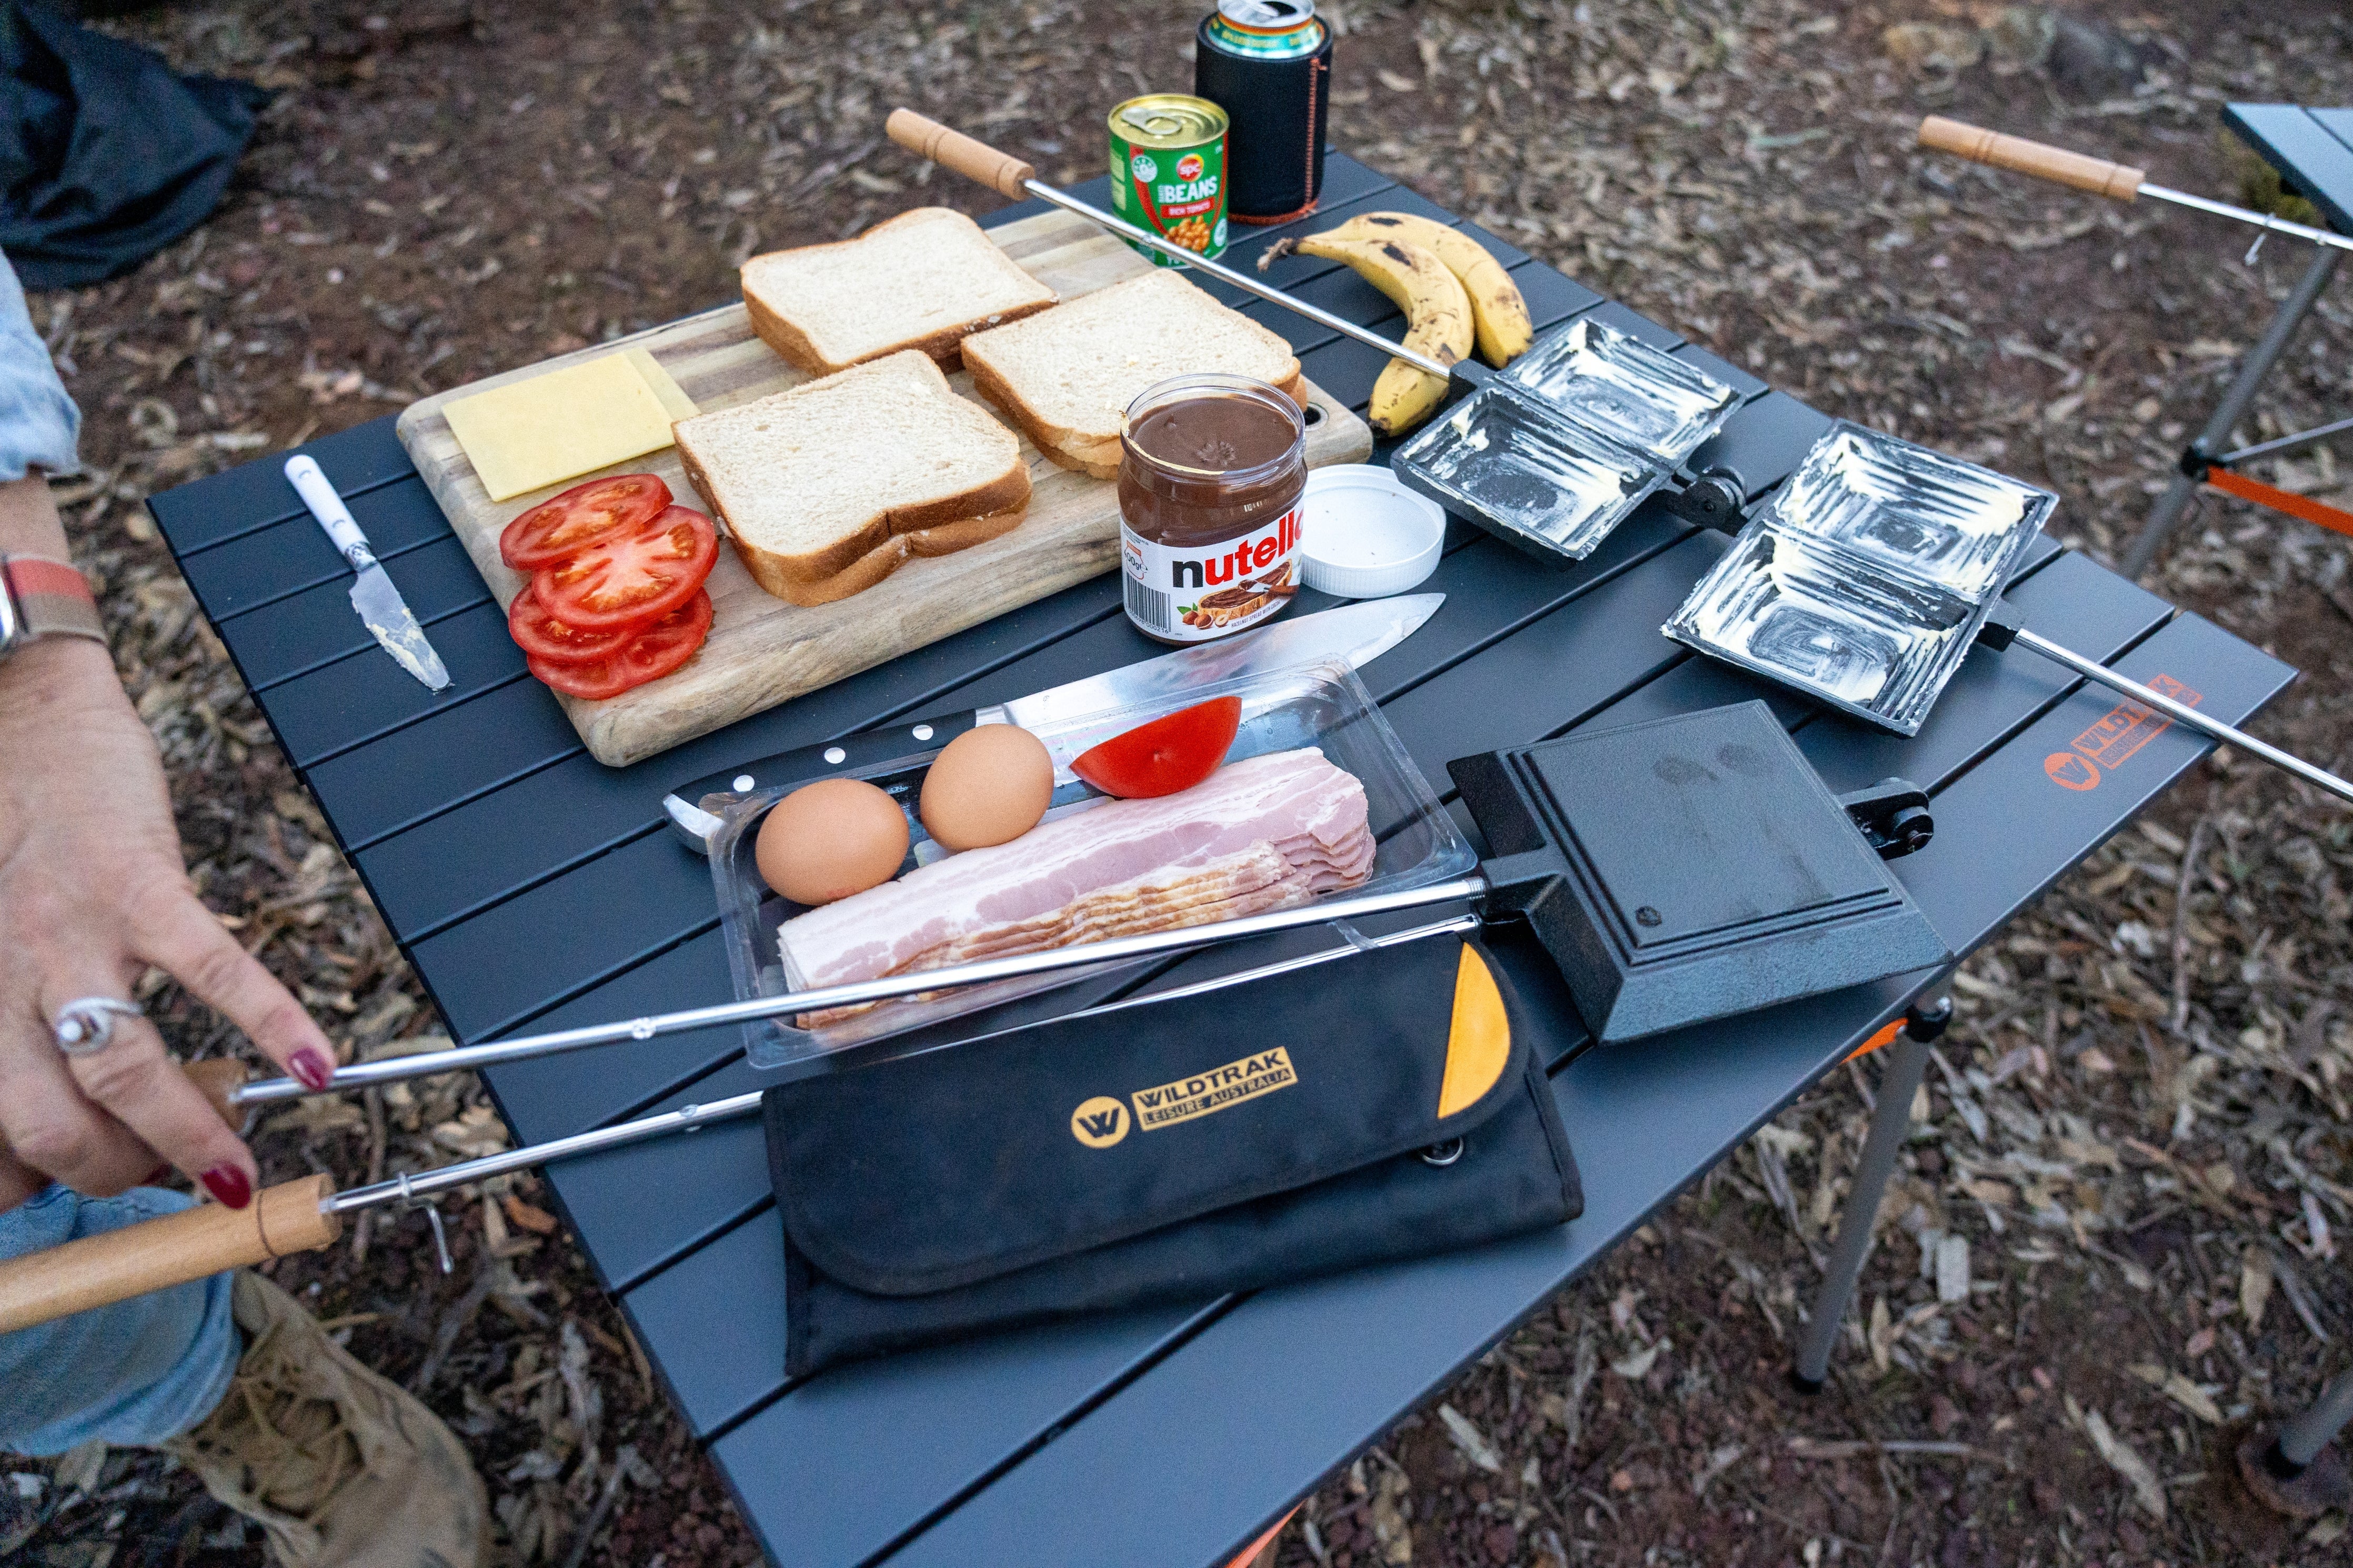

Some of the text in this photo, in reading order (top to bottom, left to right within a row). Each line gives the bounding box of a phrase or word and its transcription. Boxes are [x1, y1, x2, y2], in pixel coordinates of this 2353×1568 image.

[1164, 176, 1218, 203] BEANS
[1231, 617, 1249, 628] HAZELNUT
[1249, 611, 1262, 621] SPREAD
[1137, 1051, 1285, 1108] WILDTRAK
[1144, 1068, 1293, 1126] LEISURE AUSTRALIA
[1077, 1106, 1120, 1139] W
